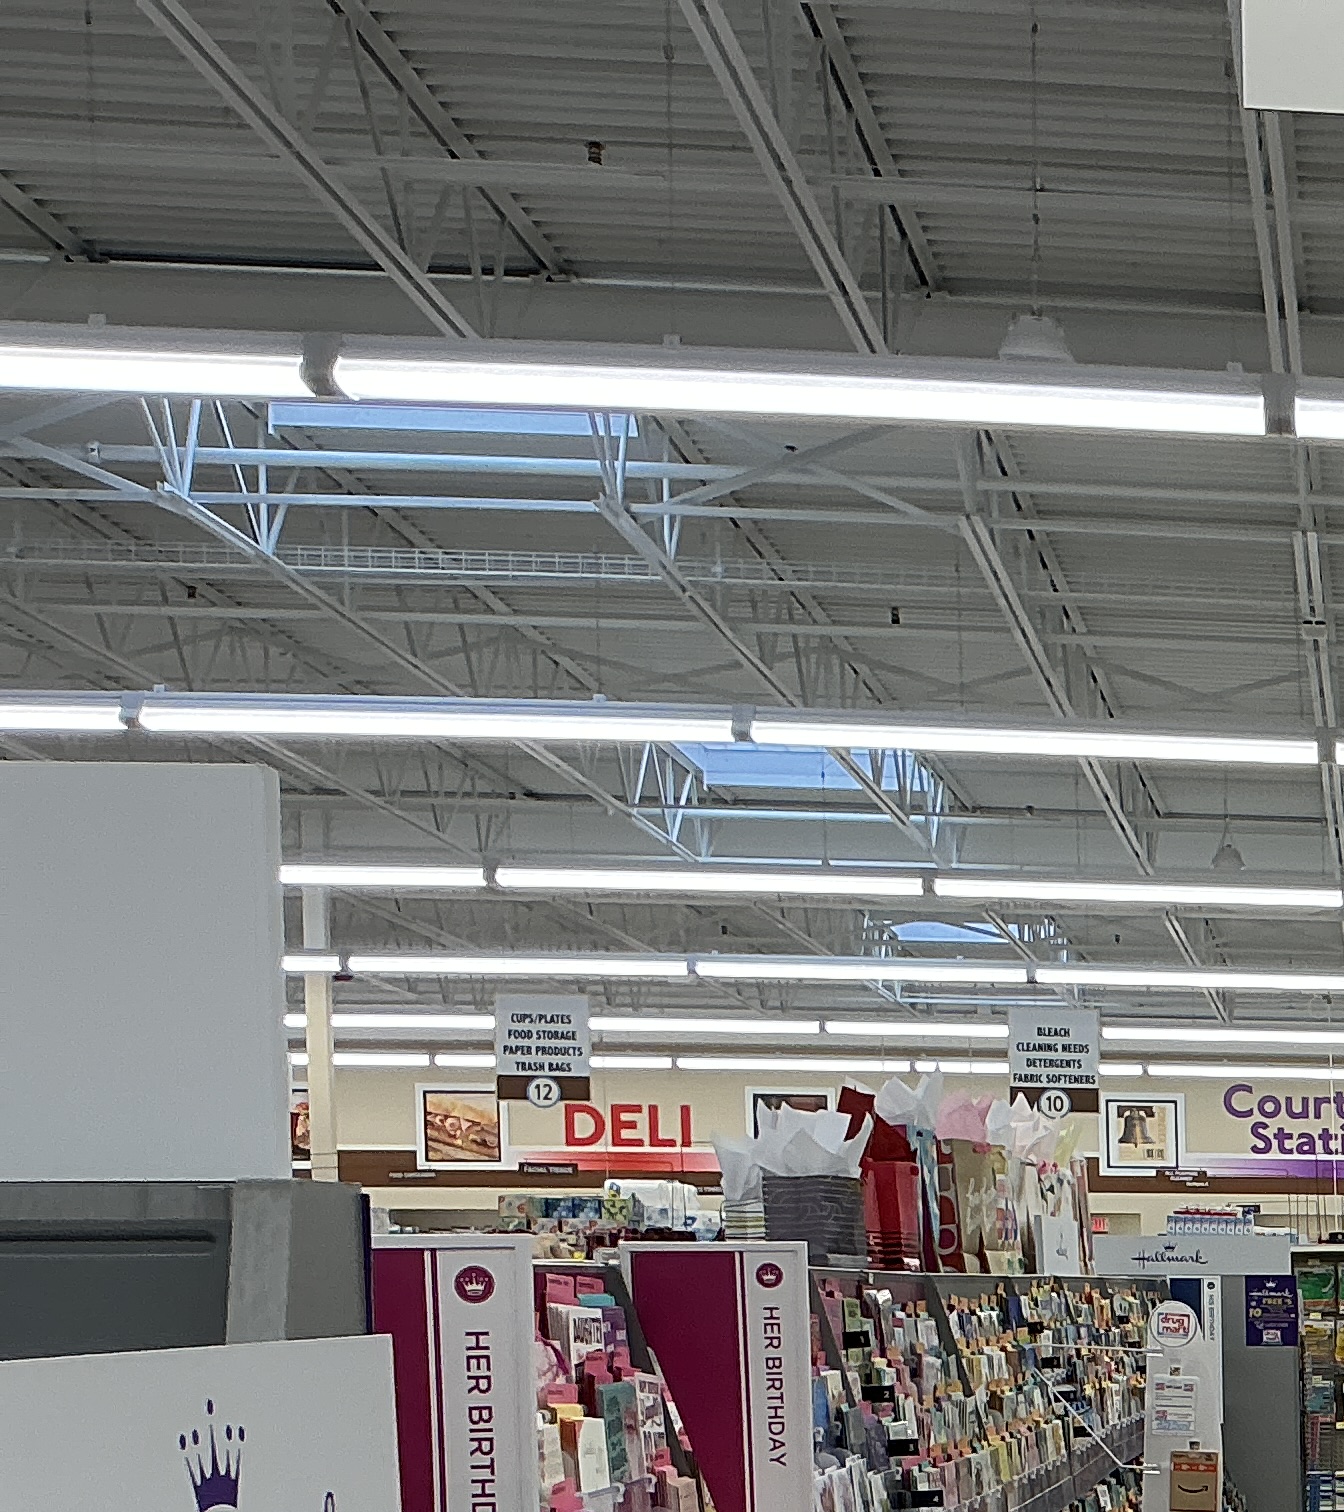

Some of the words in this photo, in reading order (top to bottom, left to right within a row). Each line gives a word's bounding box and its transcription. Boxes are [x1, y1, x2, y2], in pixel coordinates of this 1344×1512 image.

[510, 1013, 572, 1025] CUPS/PLATES
[507, 1028, 533, 1040] FOOD
[535, 1029, 577, 1041] STORAGE
[1036, 1027, 1071, 1038] BLEACH
[502, 1044, 532, 1056] PAPER
[535, 1045, 584, 1056] PRODUCTS
[1016, 1042, 1058, 1053] CLEANING
[1061, 1043, 1090, 1054] NEEDS
[514, 1061, 545, 1072] TRASH
[548, 1062, 572, 1072] BAGS
[1026, 1058, 1082, 1069] DETERGENTS
[1013, 1073, 1043, 1083] FABRIC
[1046, 1074, 1096, 1084] SOFTENERS
[534, 1084, 553, 1100] 12
[1046, 1095, 1064, 1112] 10
[563, 1103, 693, 1148] DELI
[1131, 1249, 1209, 1270] Hallmark
[1161, 1314, 1185, 1327] drug
[764, 1305, 780, 1350] HER
[1162, 1324, 1189, 1333] mart
[464, 1331, 493, 1395] HER
[883, 1390, 890, 1399] 2
[764, 1356, 788, 1467] BIRTHDAY
